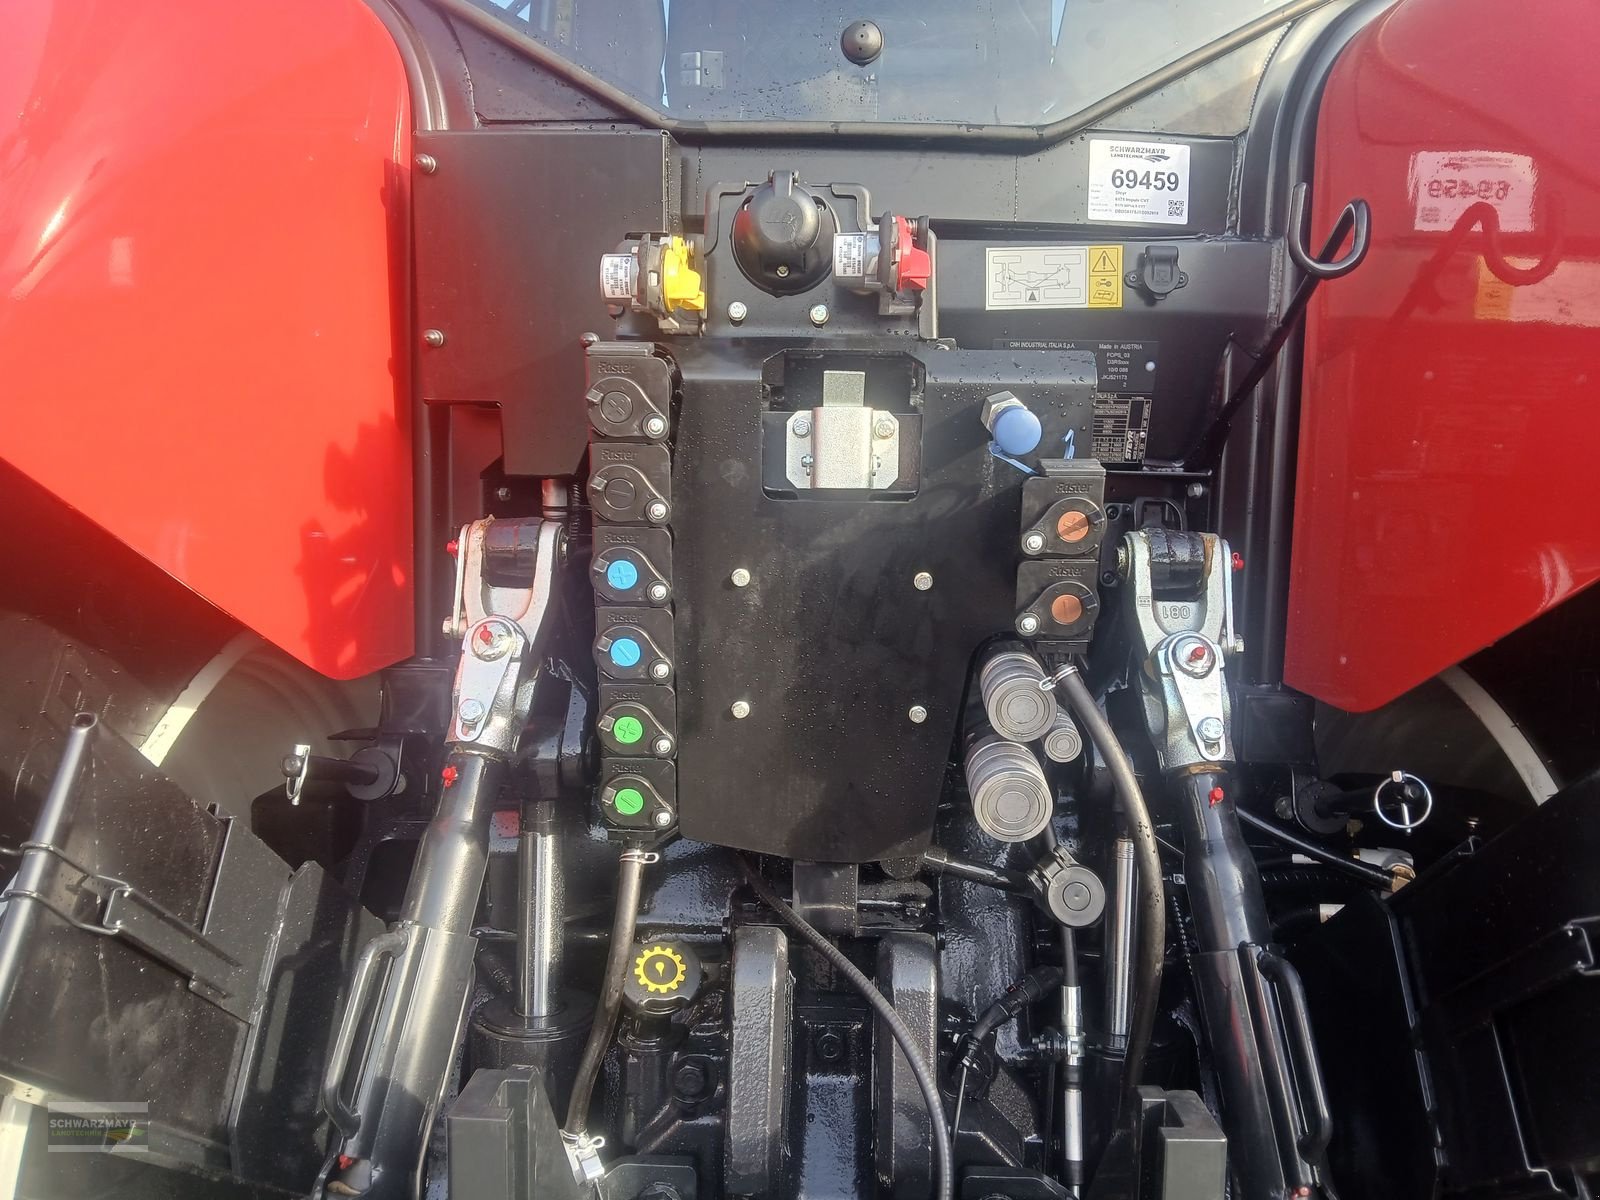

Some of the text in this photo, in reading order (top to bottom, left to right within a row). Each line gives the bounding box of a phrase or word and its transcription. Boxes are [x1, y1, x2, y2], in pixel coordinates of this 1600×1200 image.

[1109, 145, 1166, 155] SCHWARZMAYR
[1111, 169, 1180, 192] 69459
[597, 361, 635, 374] Faster
[1124, 430, 1134, 460] STEYR
[600, 449, 638, 461] Faster
[1055, 483, 1093, 494] Faster
[604, 534, 640, 545] Faster
[1048, 567, 1086, 577] Faster
